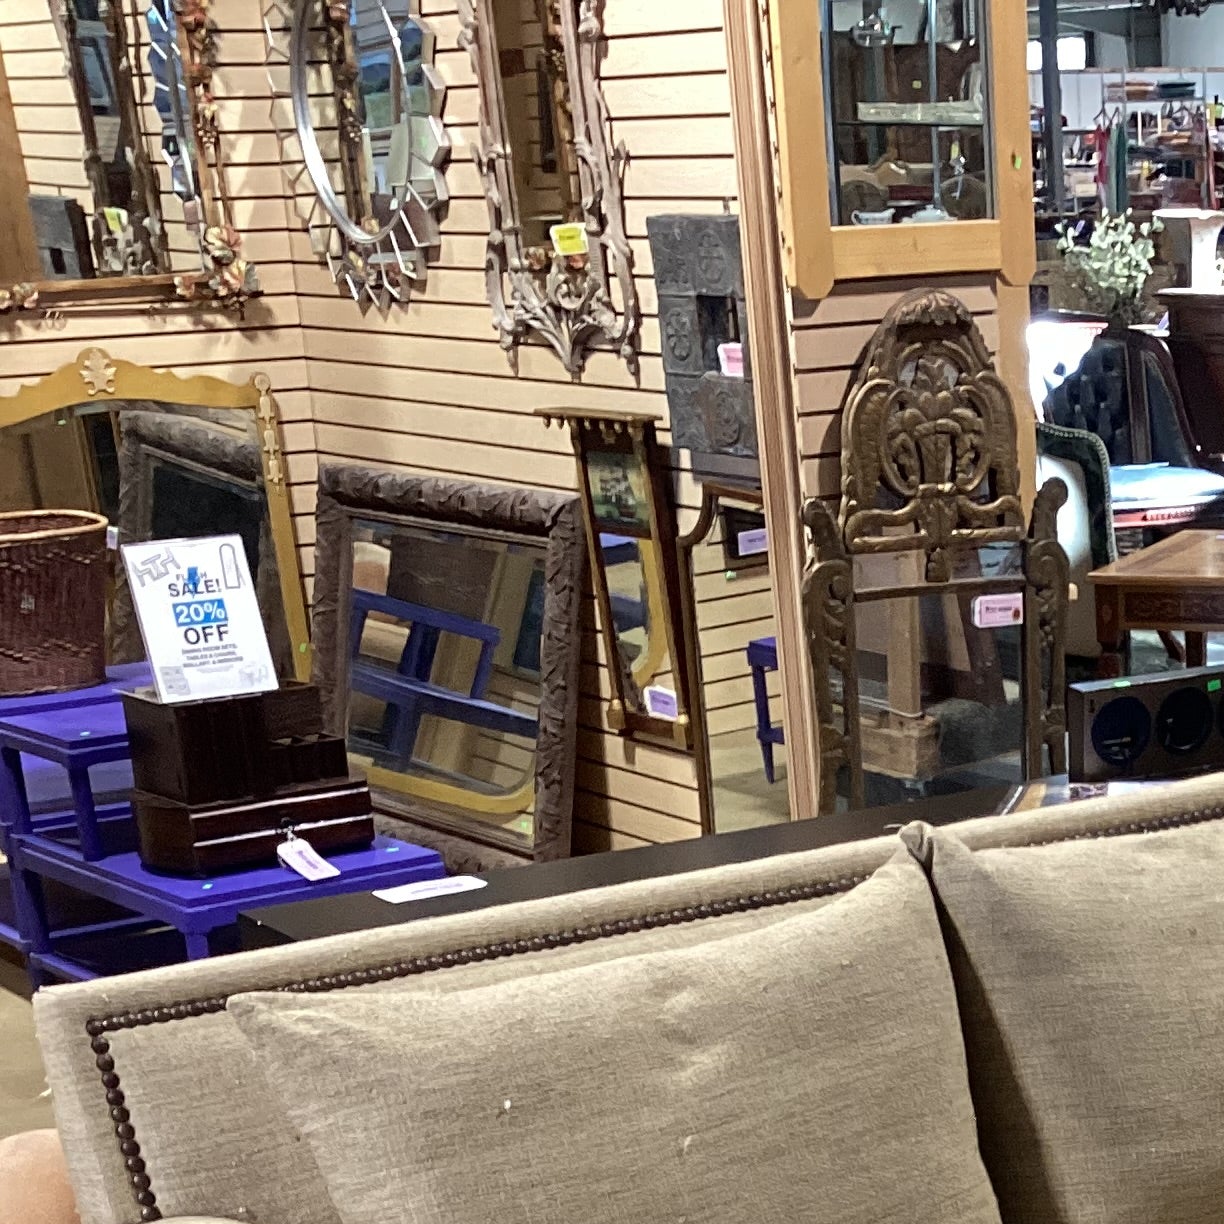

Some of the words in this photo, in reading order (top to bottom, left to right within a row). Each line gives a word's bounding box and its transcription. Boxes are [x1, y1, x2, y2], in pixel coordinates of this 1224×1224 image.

[168, 578, 222, 597] SALE!
[175, 601, 225, 623] 20%
[184, 623, 229, 645] OFF
